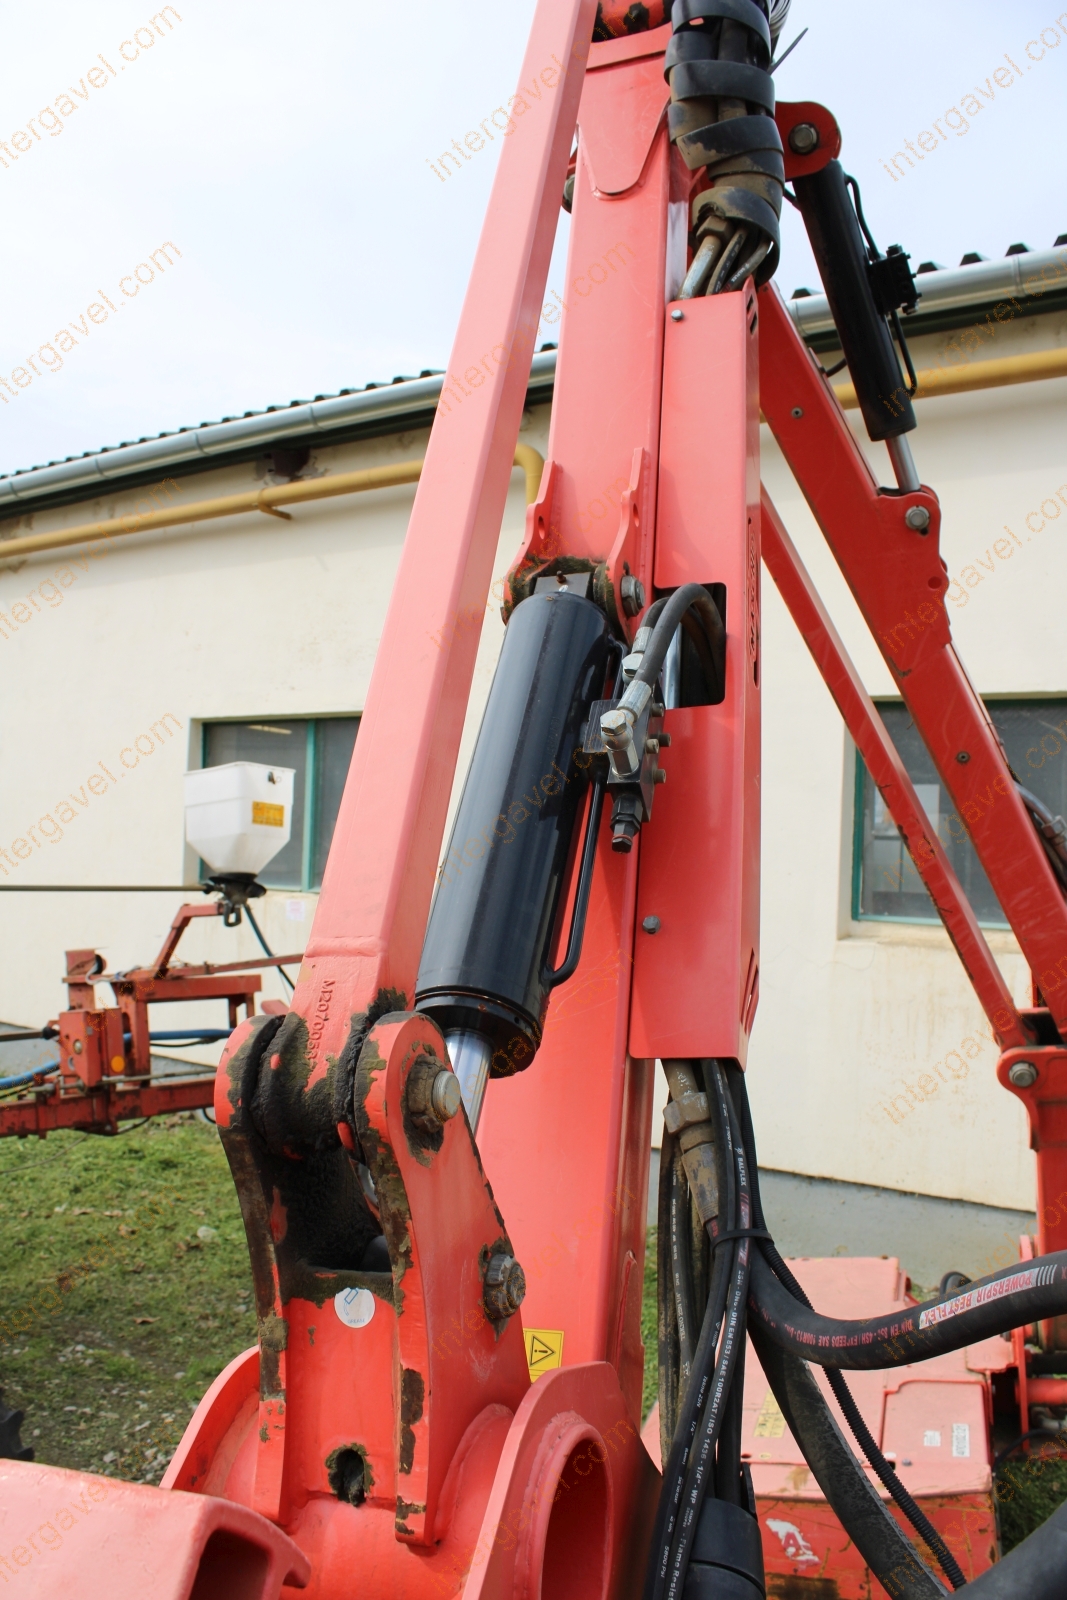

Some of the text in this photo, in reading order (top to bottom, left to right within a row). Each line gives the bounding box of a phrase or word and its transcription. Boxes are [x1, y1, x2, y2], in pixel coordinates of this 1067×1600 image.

[737, 1157, 747, 1187] BALFLEX
[976, 1271, 1033, 1303] POWERSPIR
[729, 1312, 738, 1327] DIN
[727, 1327, 735, 1339] EN
[818, 1335, 830, 1347] SAE
[724, 1339, 732, 1354] 853
[719, 1359, 730, 1376] SAE
[710, 1377, 725, 1414] 100R2AT
[706, 1418, 716, 1435] ISO
[700, 1438, 711, 1460] 1436
[690, 1489, 699, 1505] WP
[674, 1538, 687, 1568] Flame
